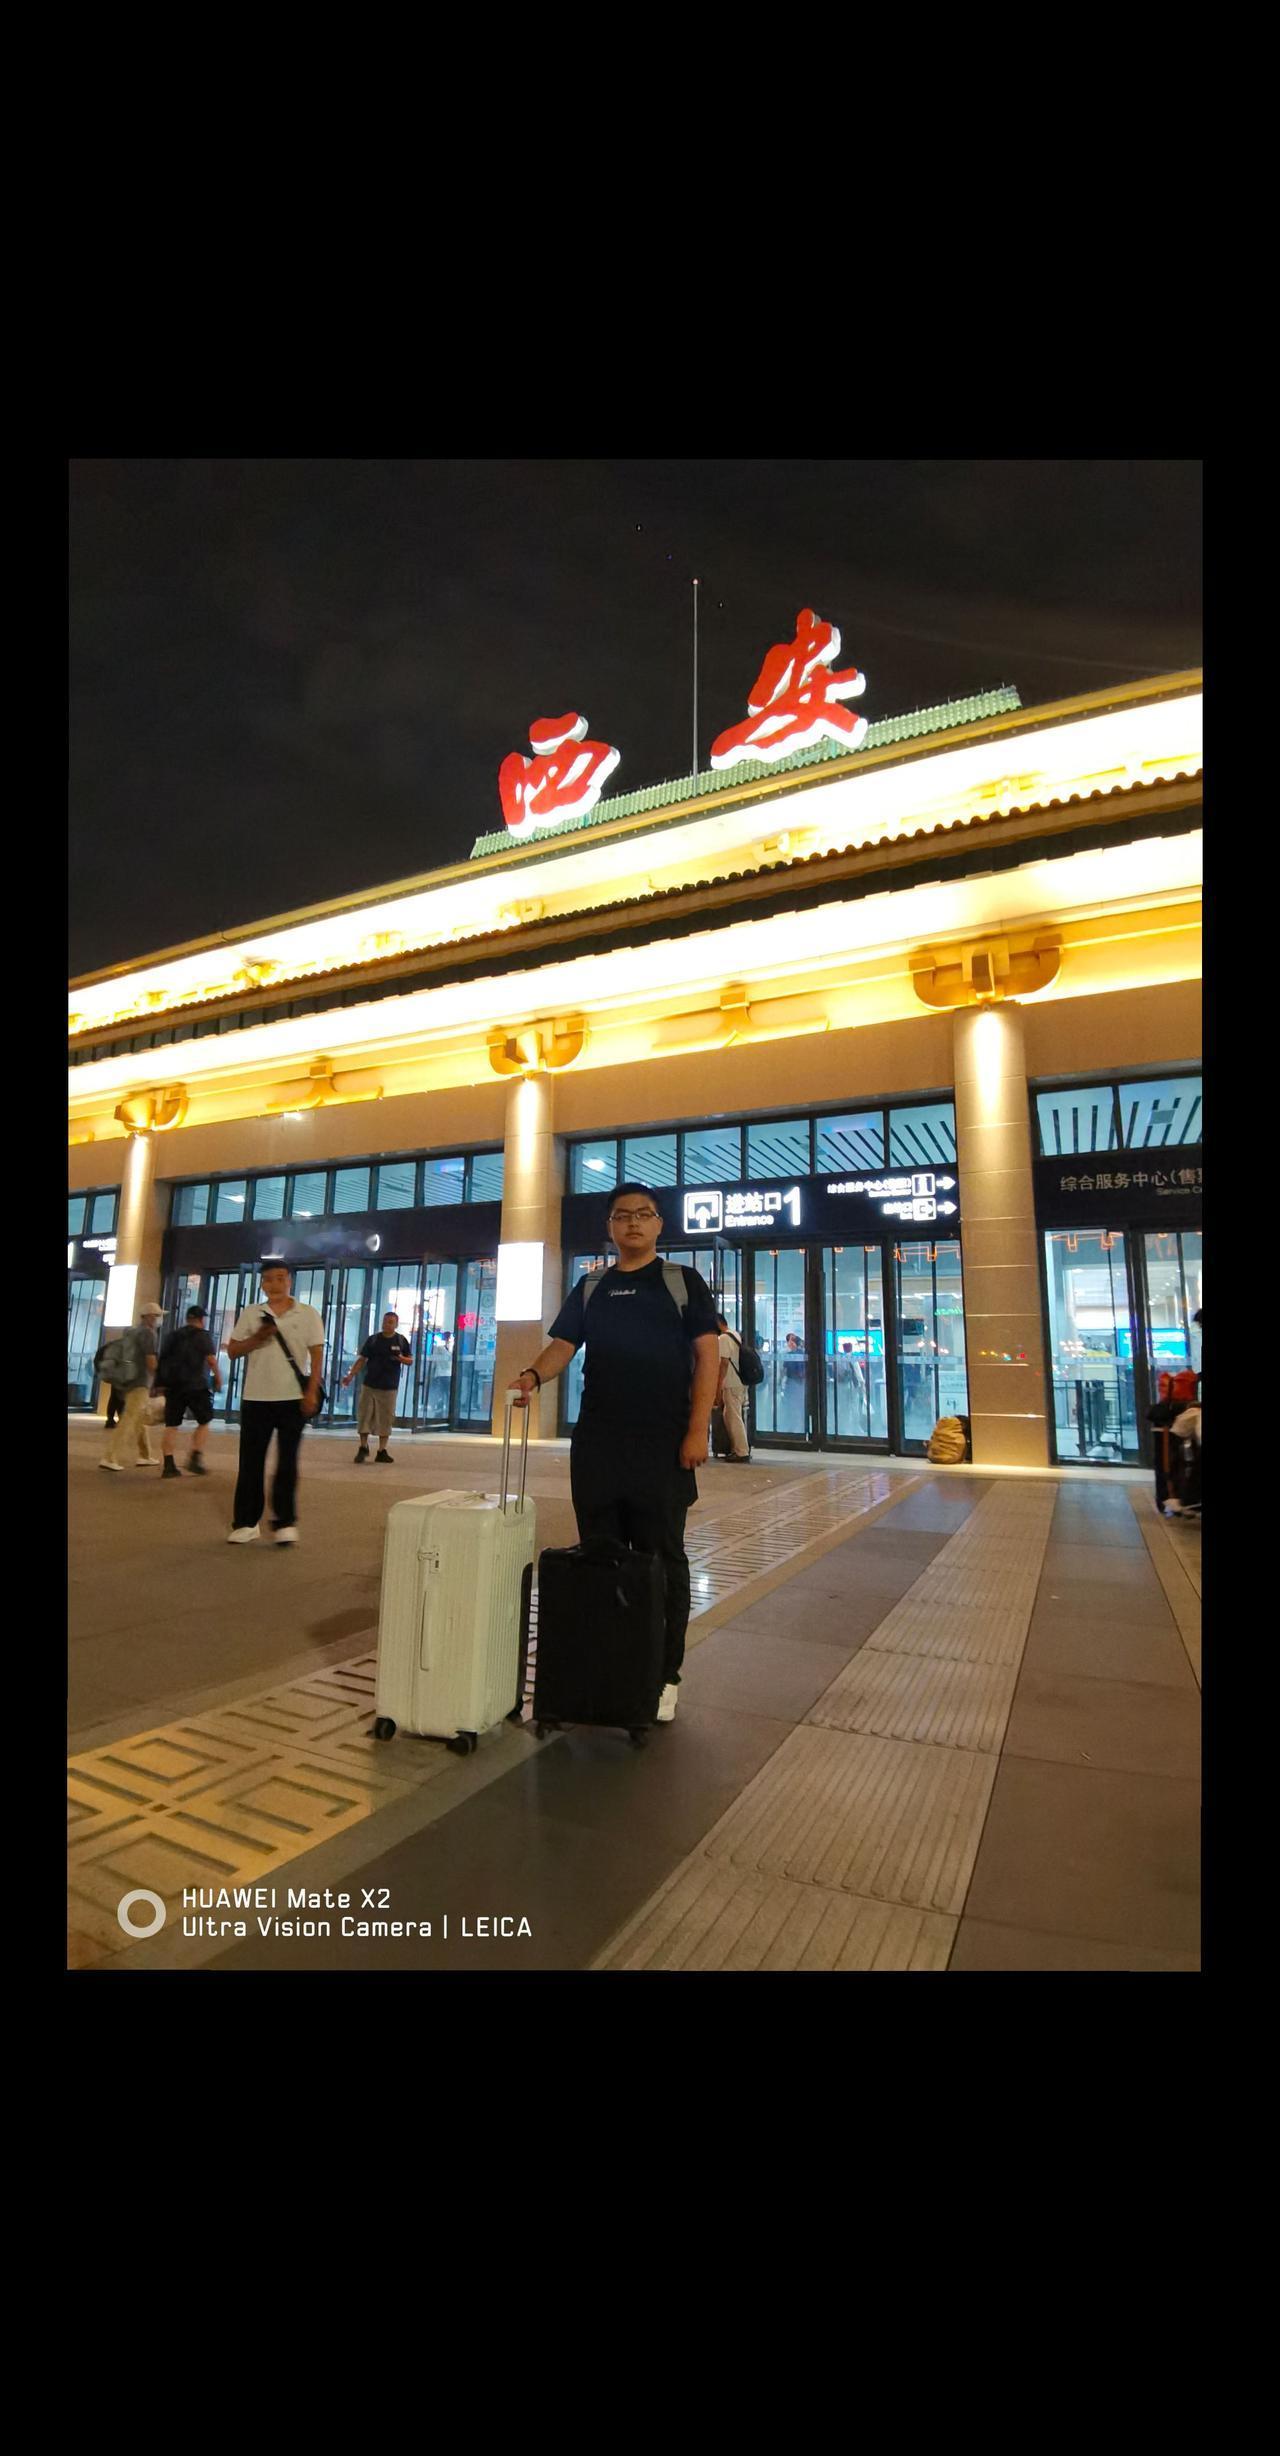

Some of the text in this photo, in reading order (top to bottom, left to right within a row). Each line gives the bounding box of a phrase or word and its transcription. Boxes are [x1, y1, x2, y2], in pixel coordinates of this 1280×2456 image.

[498, 608, 868, 838] 西安
[726, 1192, 782, 1215] 进站口
[724, 1215, 775, 1228] Entrance
